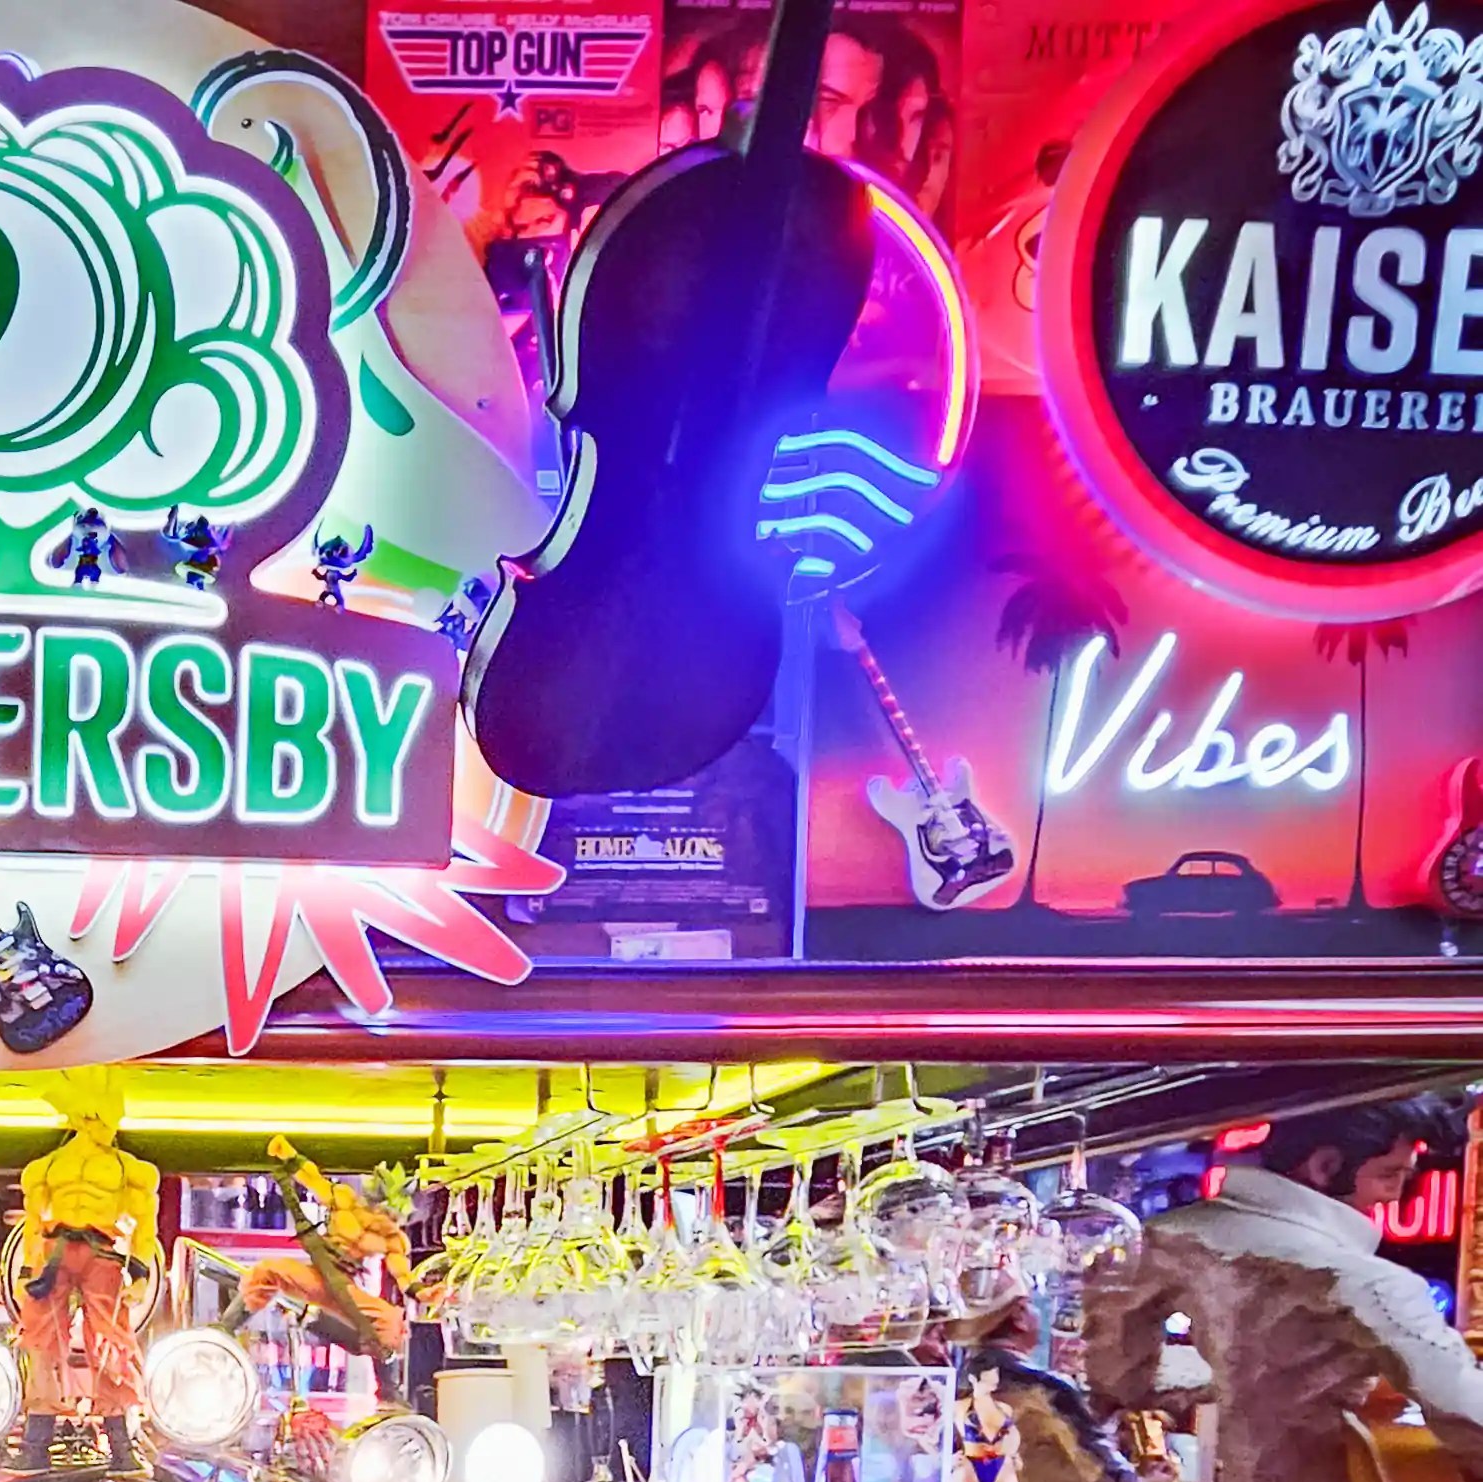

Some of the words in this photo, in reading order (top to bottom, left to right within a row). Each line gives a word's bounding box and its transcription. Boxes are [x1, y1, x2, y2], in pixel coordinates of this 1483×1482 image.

[448, 31, 508, 76] TOP
[512, 31, 582, 77] GUN
[536, 107, 568, 132] PG
[1119, 216, 1483, 376] KAISE
[1168, 447, 1383, 552] Premium
[1048, 630, 1353, 792] Vibes
[575, 836, 634, 861] HOME
